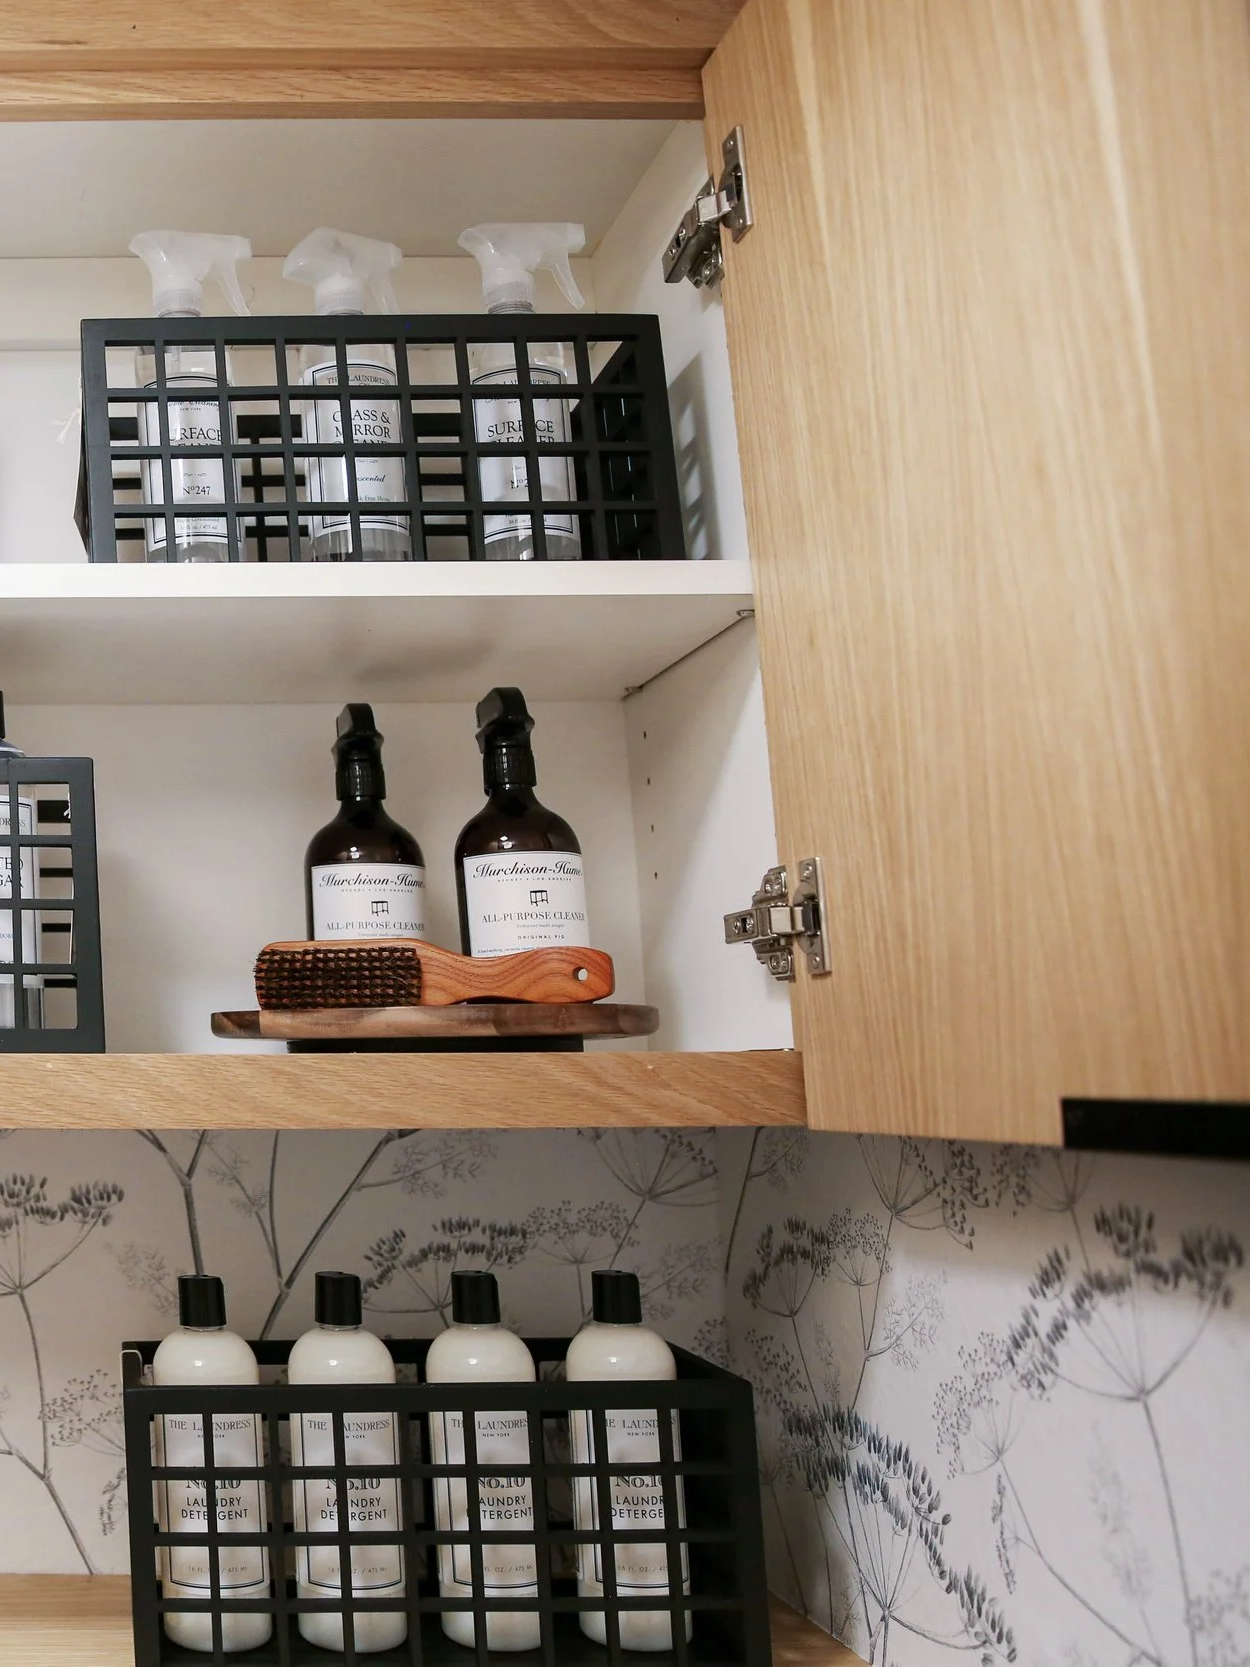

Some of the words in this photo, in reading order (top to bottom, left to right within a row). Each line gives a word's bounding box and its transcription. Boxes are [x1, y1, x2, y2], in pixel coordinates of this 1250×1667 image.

[380, 411, 391, 424] &
[335, 424, 392, 440] MRROR
[487, 419, 554, 438] SURFCE
[482, 912, 552, 924] ALL-PURPOSE
[326, 921, 391, 931] ALL-PURPOSE
[169, 1420, 187, 1430] THE
[193, 1418, 251, 1431] LNDRESS
[308, 1420, 327, 1430] THE
[343, 1419, 390, 1432] AUNDRESS
[451, 1418, 463, 1428] TH
[478, 1418, 528, 1430] LAUNDRES
[186, 1497, 242, 1507] LAUDRY
[326, 1497, 381, 1508] LANDRY
[478, 1495, 527, 1506] AUNDRY
[616, 1495, 664, 1506] LAUNDR
[181, 1508, 248, 1520] DETEGENT
[320, 1508, 387, 1521] DERGENT
[482, 1506, 532, 1520] TERGENT
[612, 1508, 664, 1520] DETERGE
